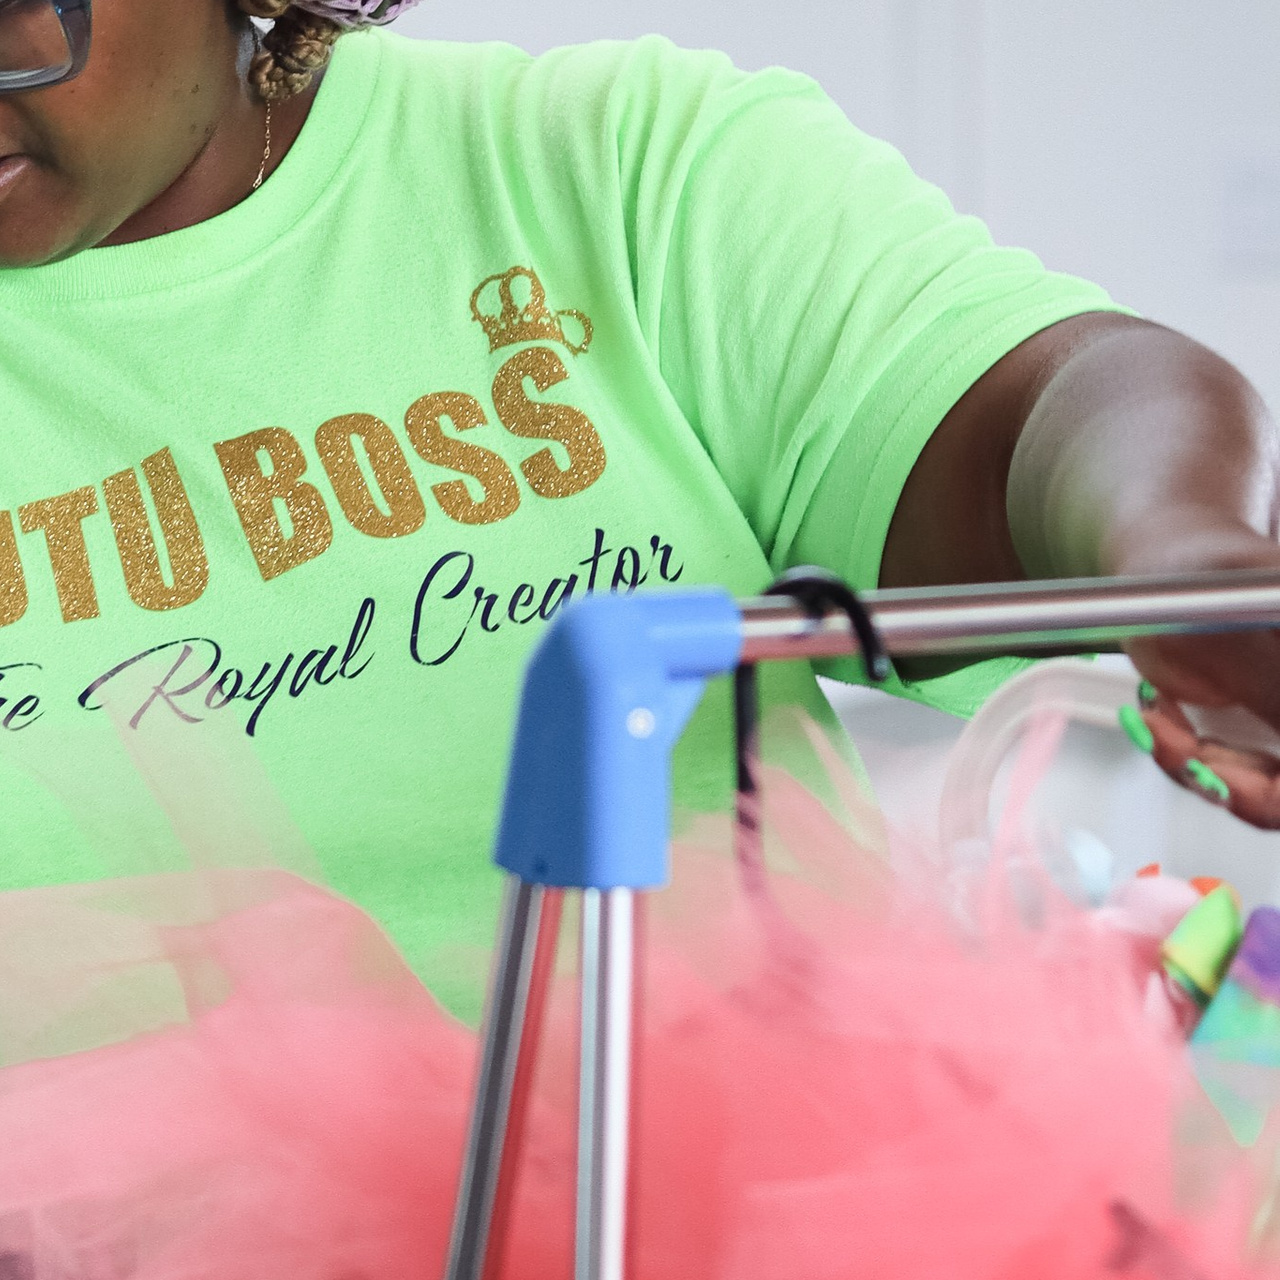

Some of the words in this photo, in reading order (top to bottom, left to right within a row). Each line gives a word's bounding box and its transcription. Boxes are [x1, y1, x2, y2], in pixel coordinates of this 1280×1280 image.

[213, 346, 607, 581] BOSS
[77, 597, 374, 736] Royal
[409, 527, 684, 666] Creator
